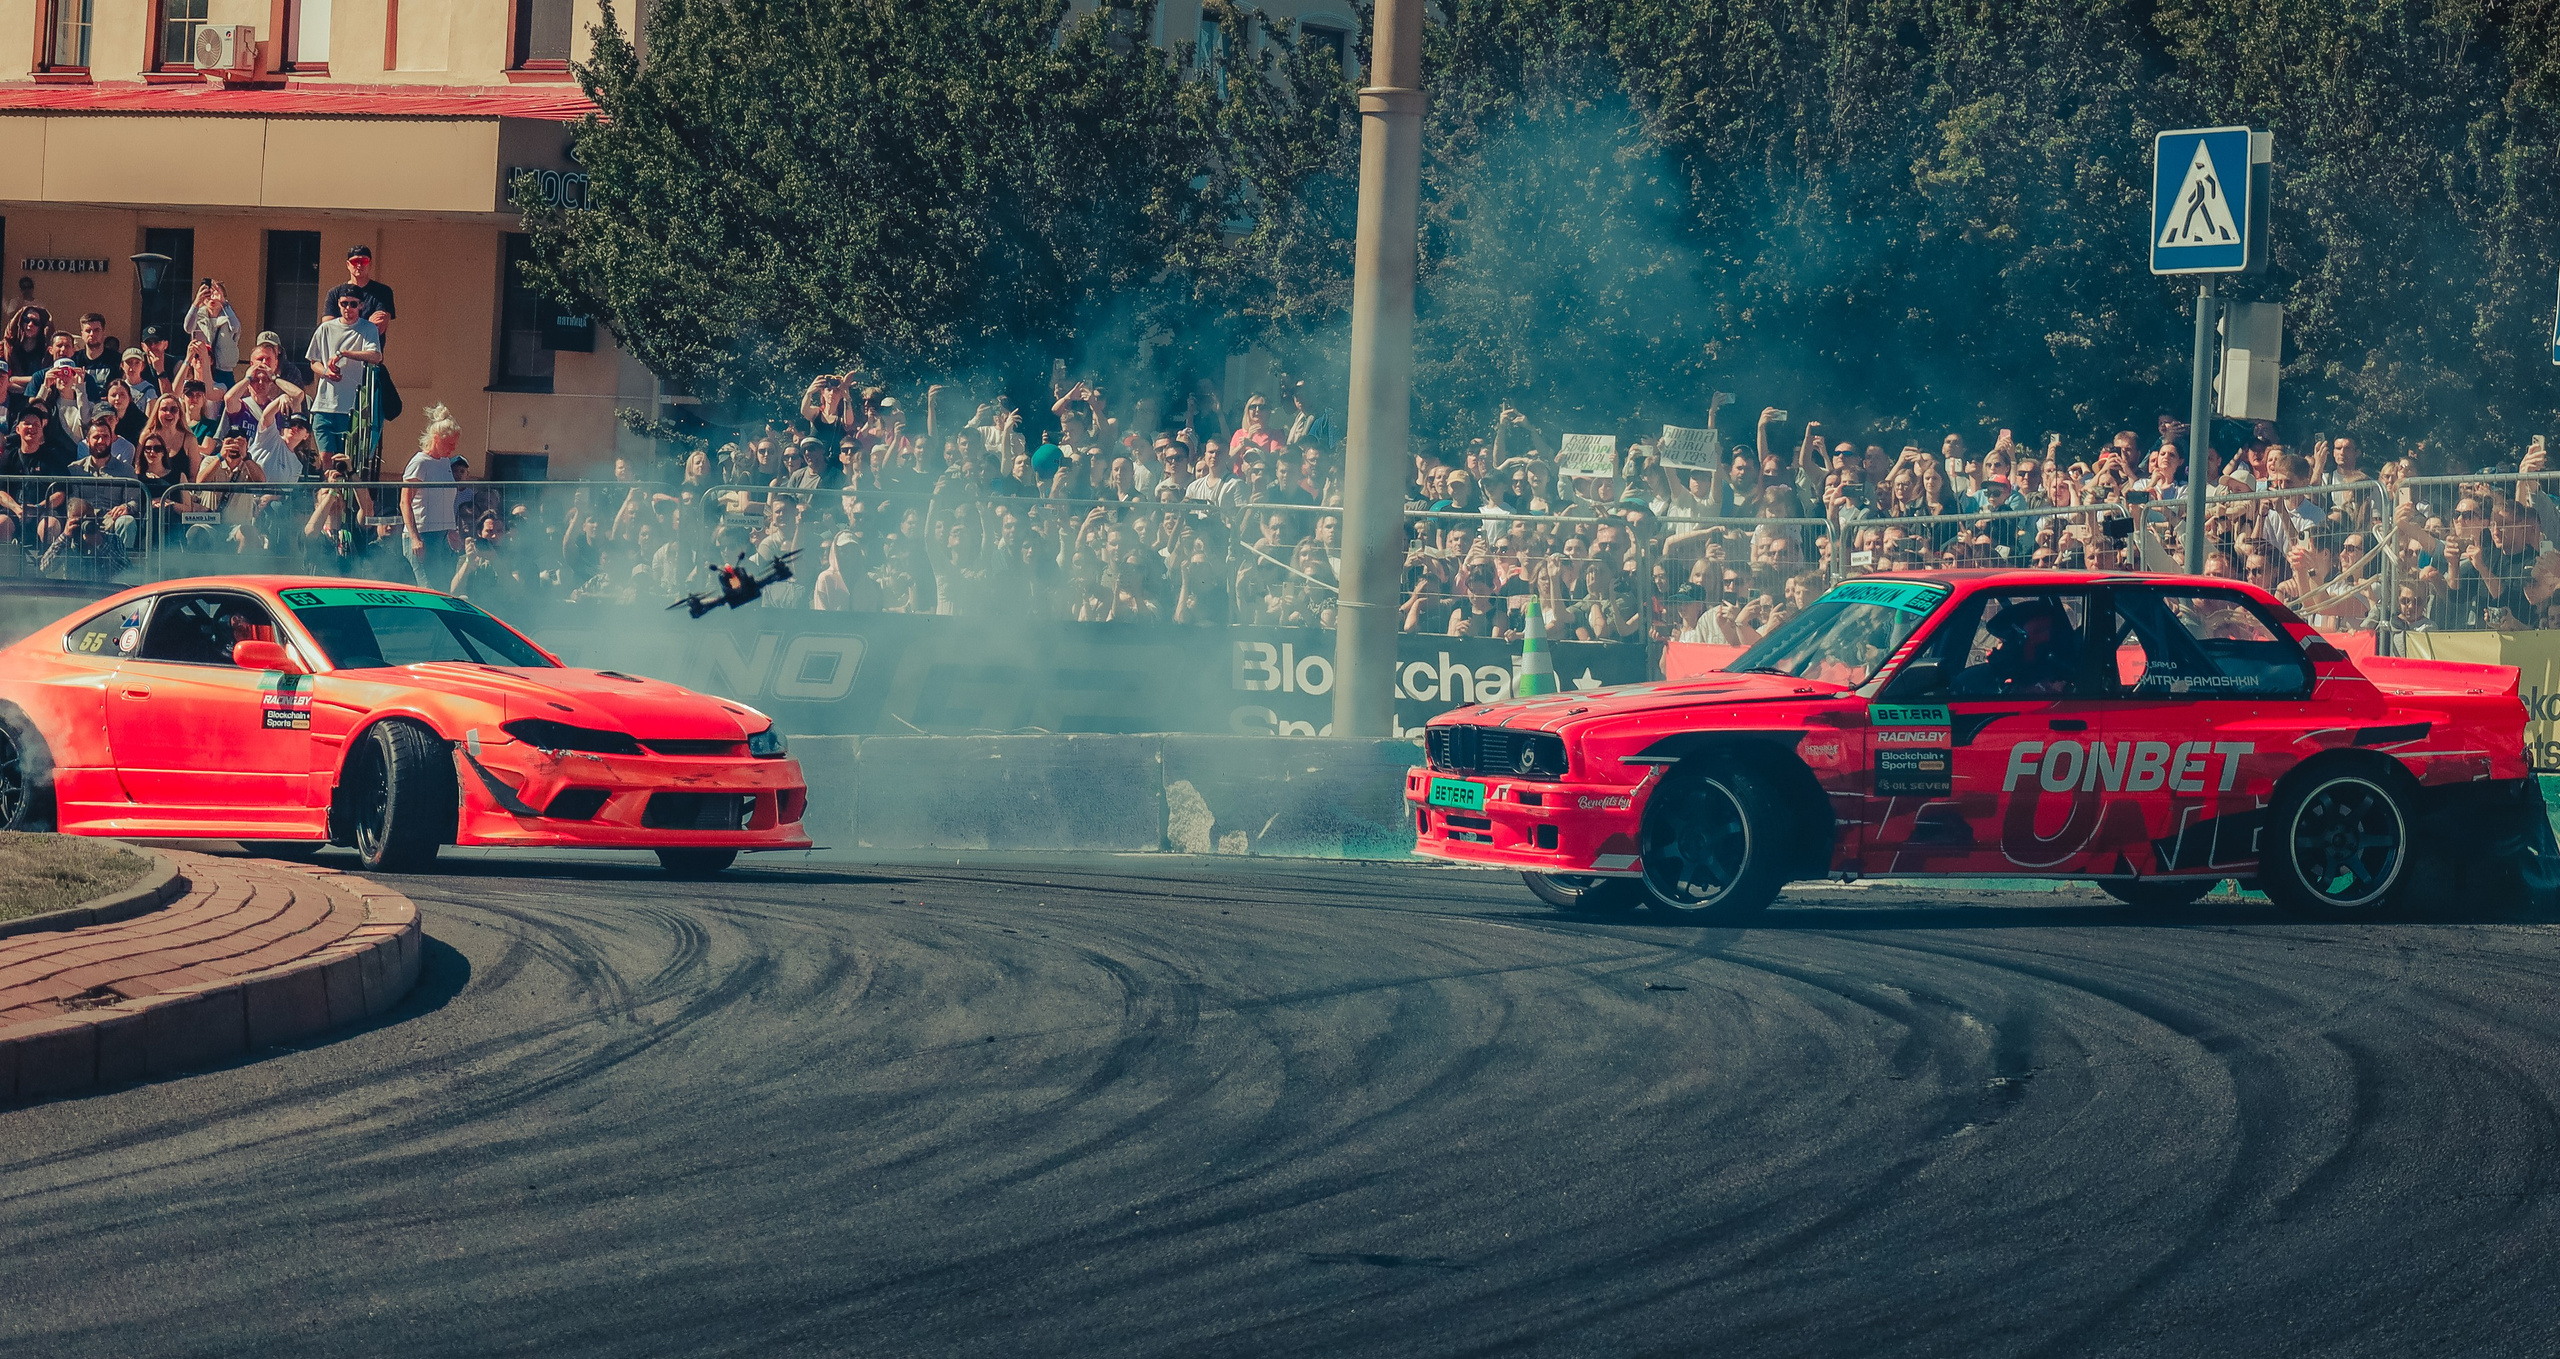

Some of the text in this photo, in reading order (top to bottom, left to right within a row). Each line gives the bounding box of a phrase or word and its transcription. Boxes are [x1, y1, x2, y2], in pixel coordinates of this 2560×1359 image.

[21, 259, 104, 272] ПРОХОДНАЯ
[556, 316, 587, 328] ПЯТНИЦА
[296, 592, 317, 606] 55
[79, 631, 108, 653] 55
[1232, 640, 1560, 704] Blochai
[2133, 675, 2259, 687] DMITRY SAMOSHKIN
[267, 711, 307, 720] Blockchain
[266, 718, 292, 728] Sports
[1877, 731, 1947, 742] RACING.BY
[1881, 752, 1938, 760] Blockchain
[1881, 761, 1917, 771] Sports
[2002, 740, 2255, 792] FONBET
[1910, 782, 1950, 790] SEVEN
[1577, 795, 1617, 809] Benefits
